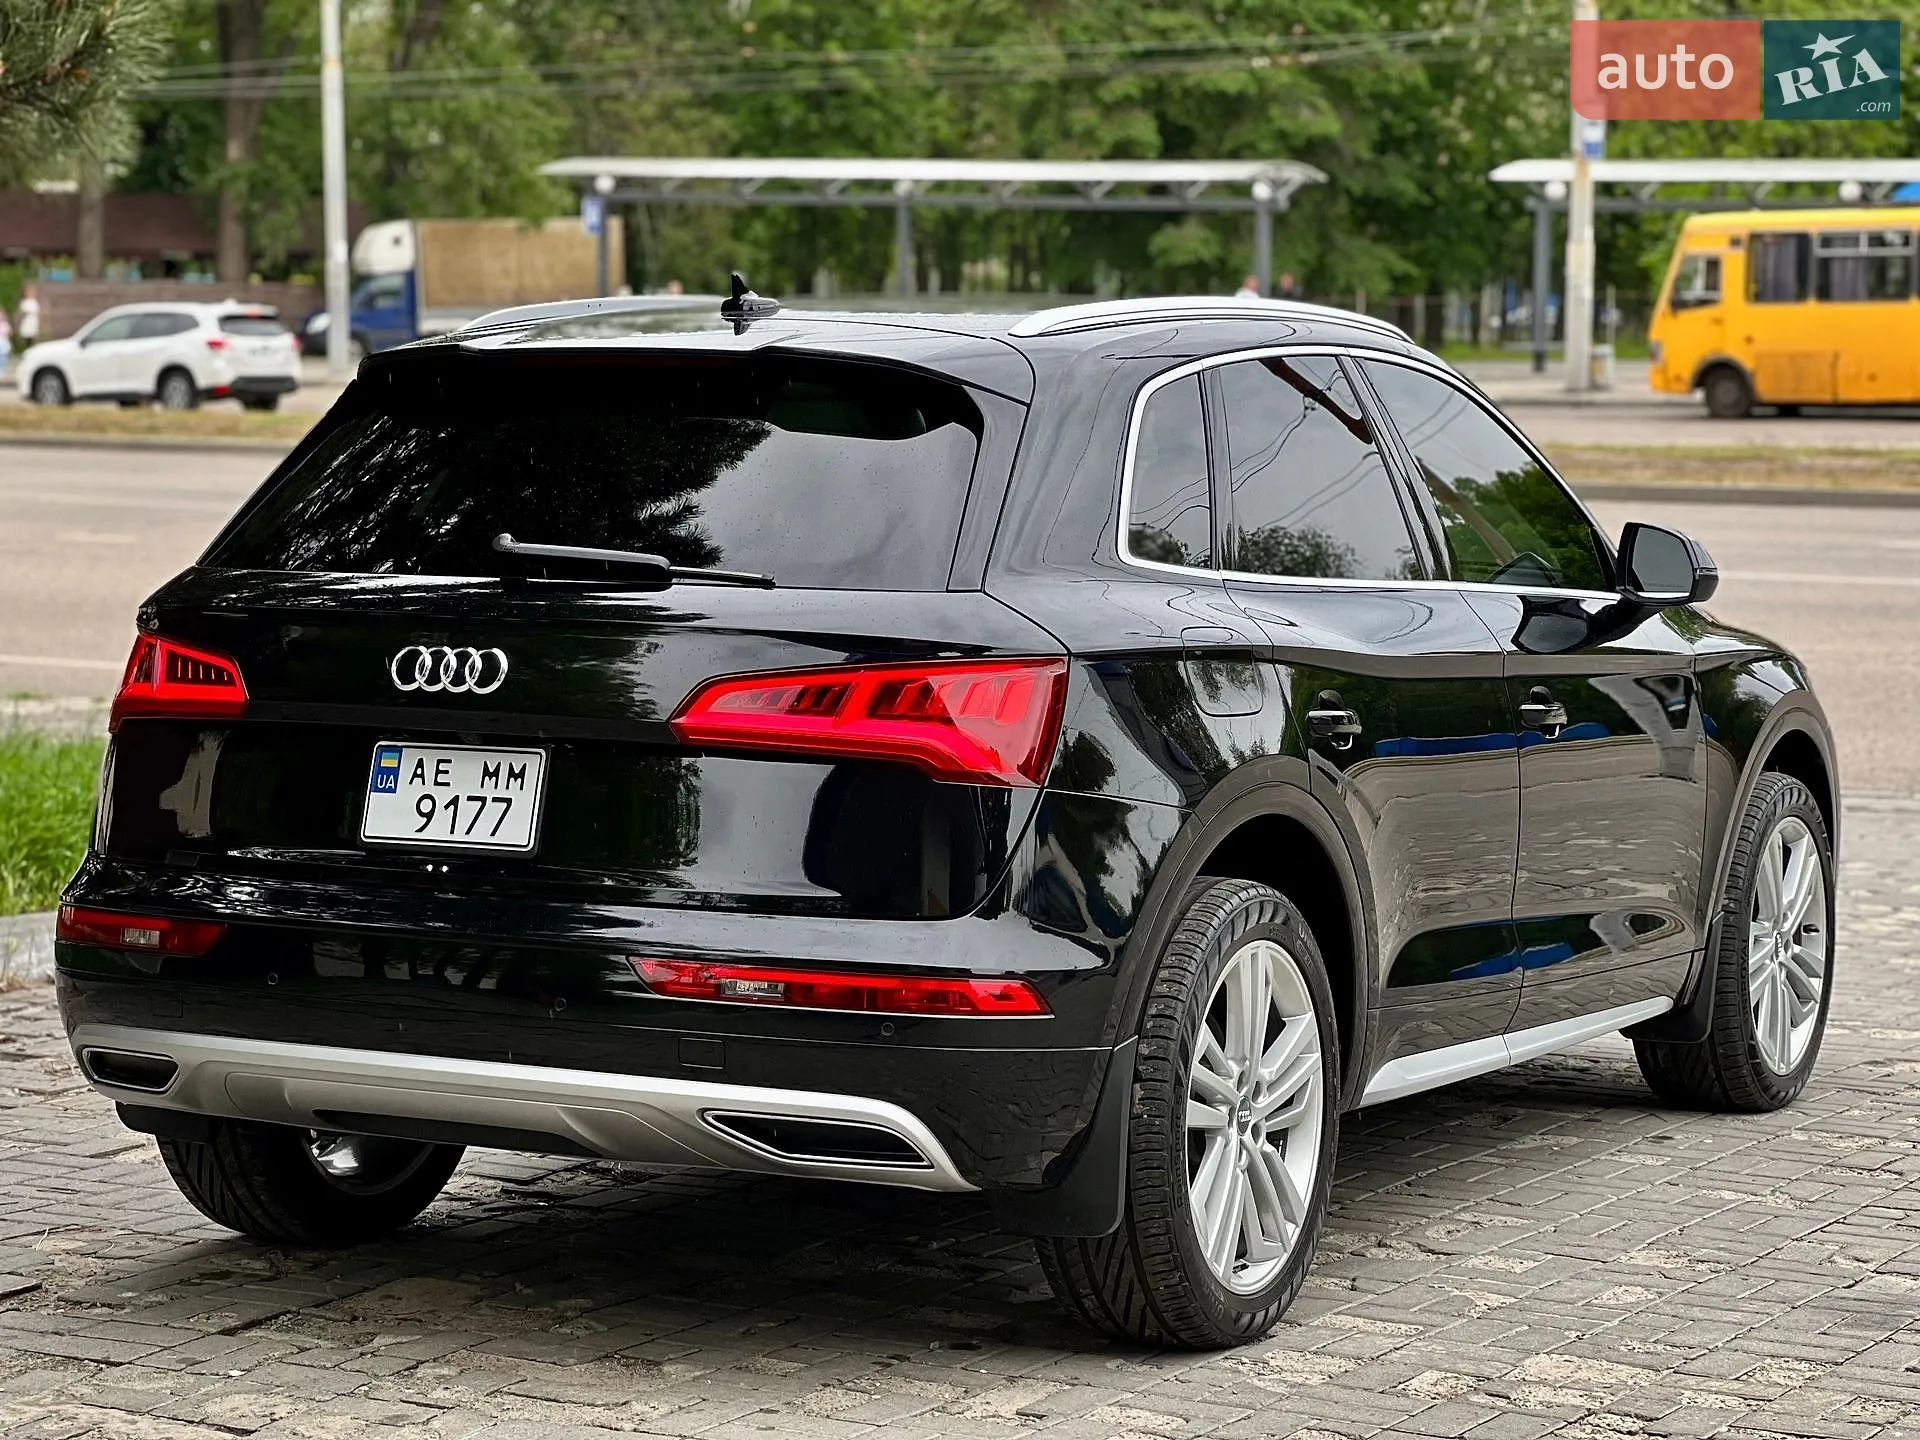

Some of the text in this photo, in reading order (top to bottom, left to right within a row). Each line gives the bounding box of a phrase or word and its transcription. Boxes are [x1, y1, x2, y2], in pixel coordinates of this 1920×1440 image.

[377, 774, 395, 789] UA
[408, 757, 528, 791] AE MM
[415, 793, 513, 837] 9177
